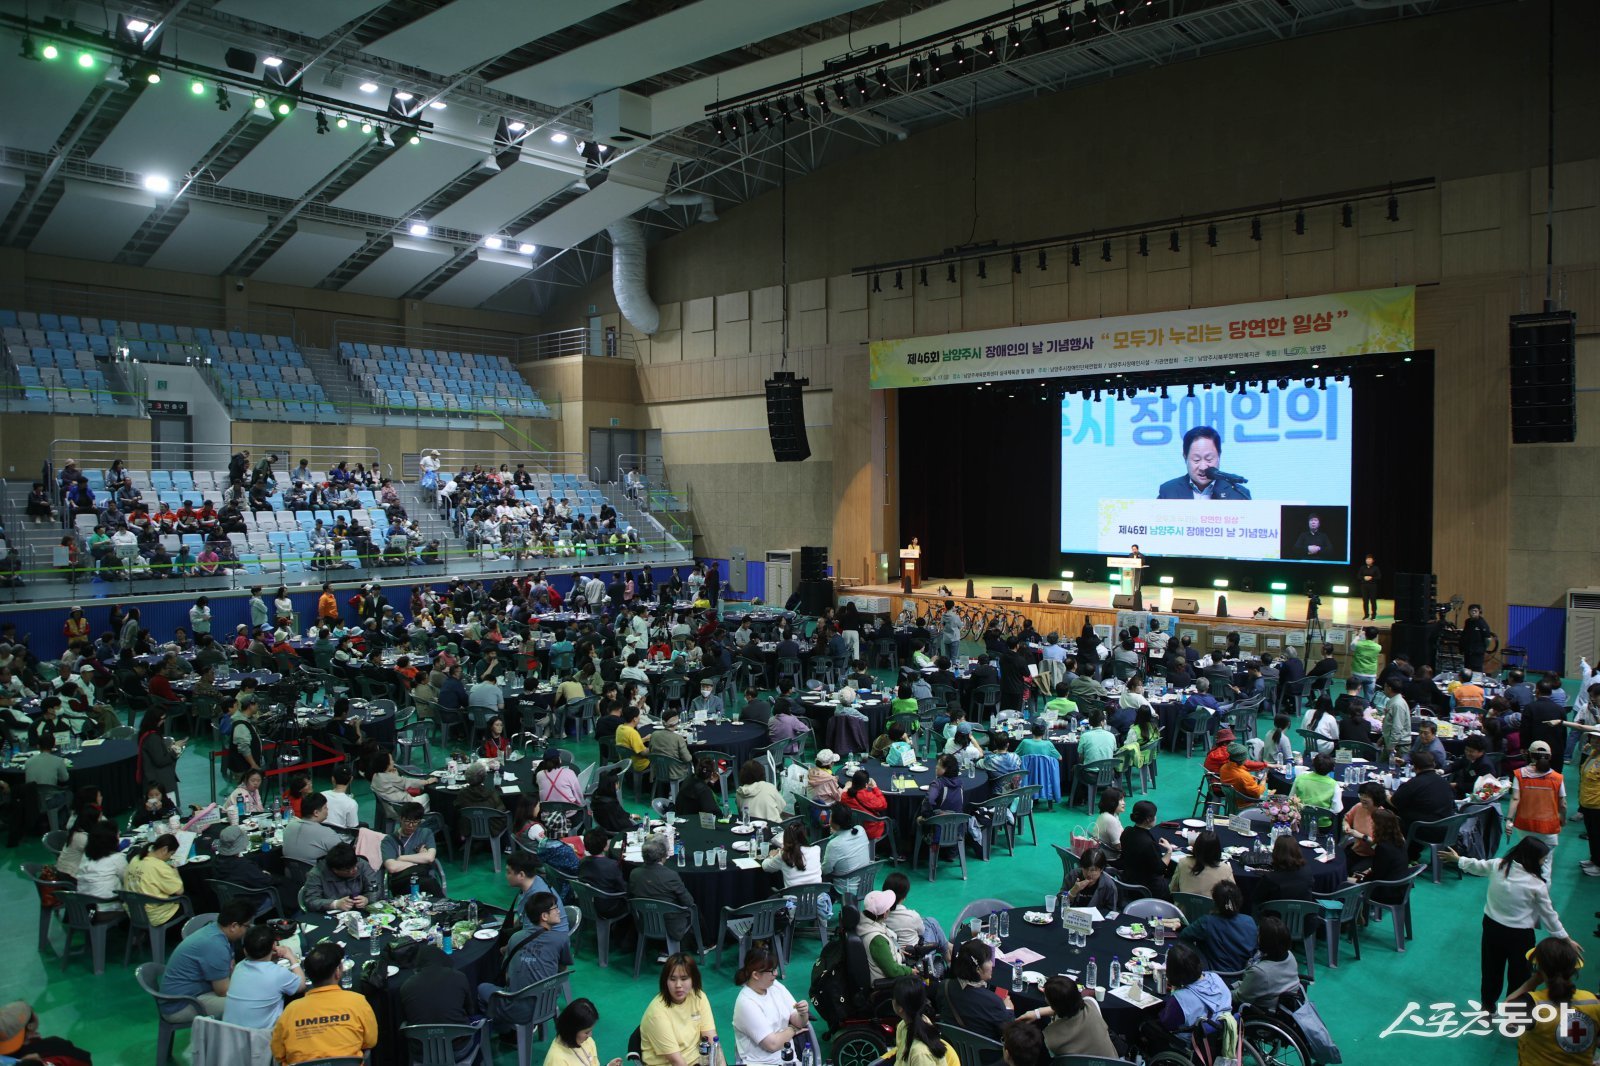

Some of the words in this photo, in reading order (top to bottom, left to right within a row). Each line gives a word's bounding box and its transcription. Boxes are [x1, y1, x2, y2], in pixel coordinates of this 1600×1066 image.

[907, 351, 940, 364] 제46회
[942, 347, 981, 362] 남양주시
[985, 342, 1029, 358] 장애인의
[1032, 341, 1044, 354] 날
[1046, 337, 1094, 352] 기념행사
[1169, 323, 1223, 345] 누리는
[1228, 316, 1288, 340] 당연한
[1061, 395, 1115, 447] 시
[1130, 385, 1338, 446] 장애인의
[1118, 524, 1148, 536] 제46회
[1149, 525, 1184, 537] 남양주시
[1186, 526, 1224, 538] 장애인의
[1225, 527, 1236, 538] 날
[1238, 528, 1278, 540] 기념행사
[295, 1013, 351, 1027] UMBRO
